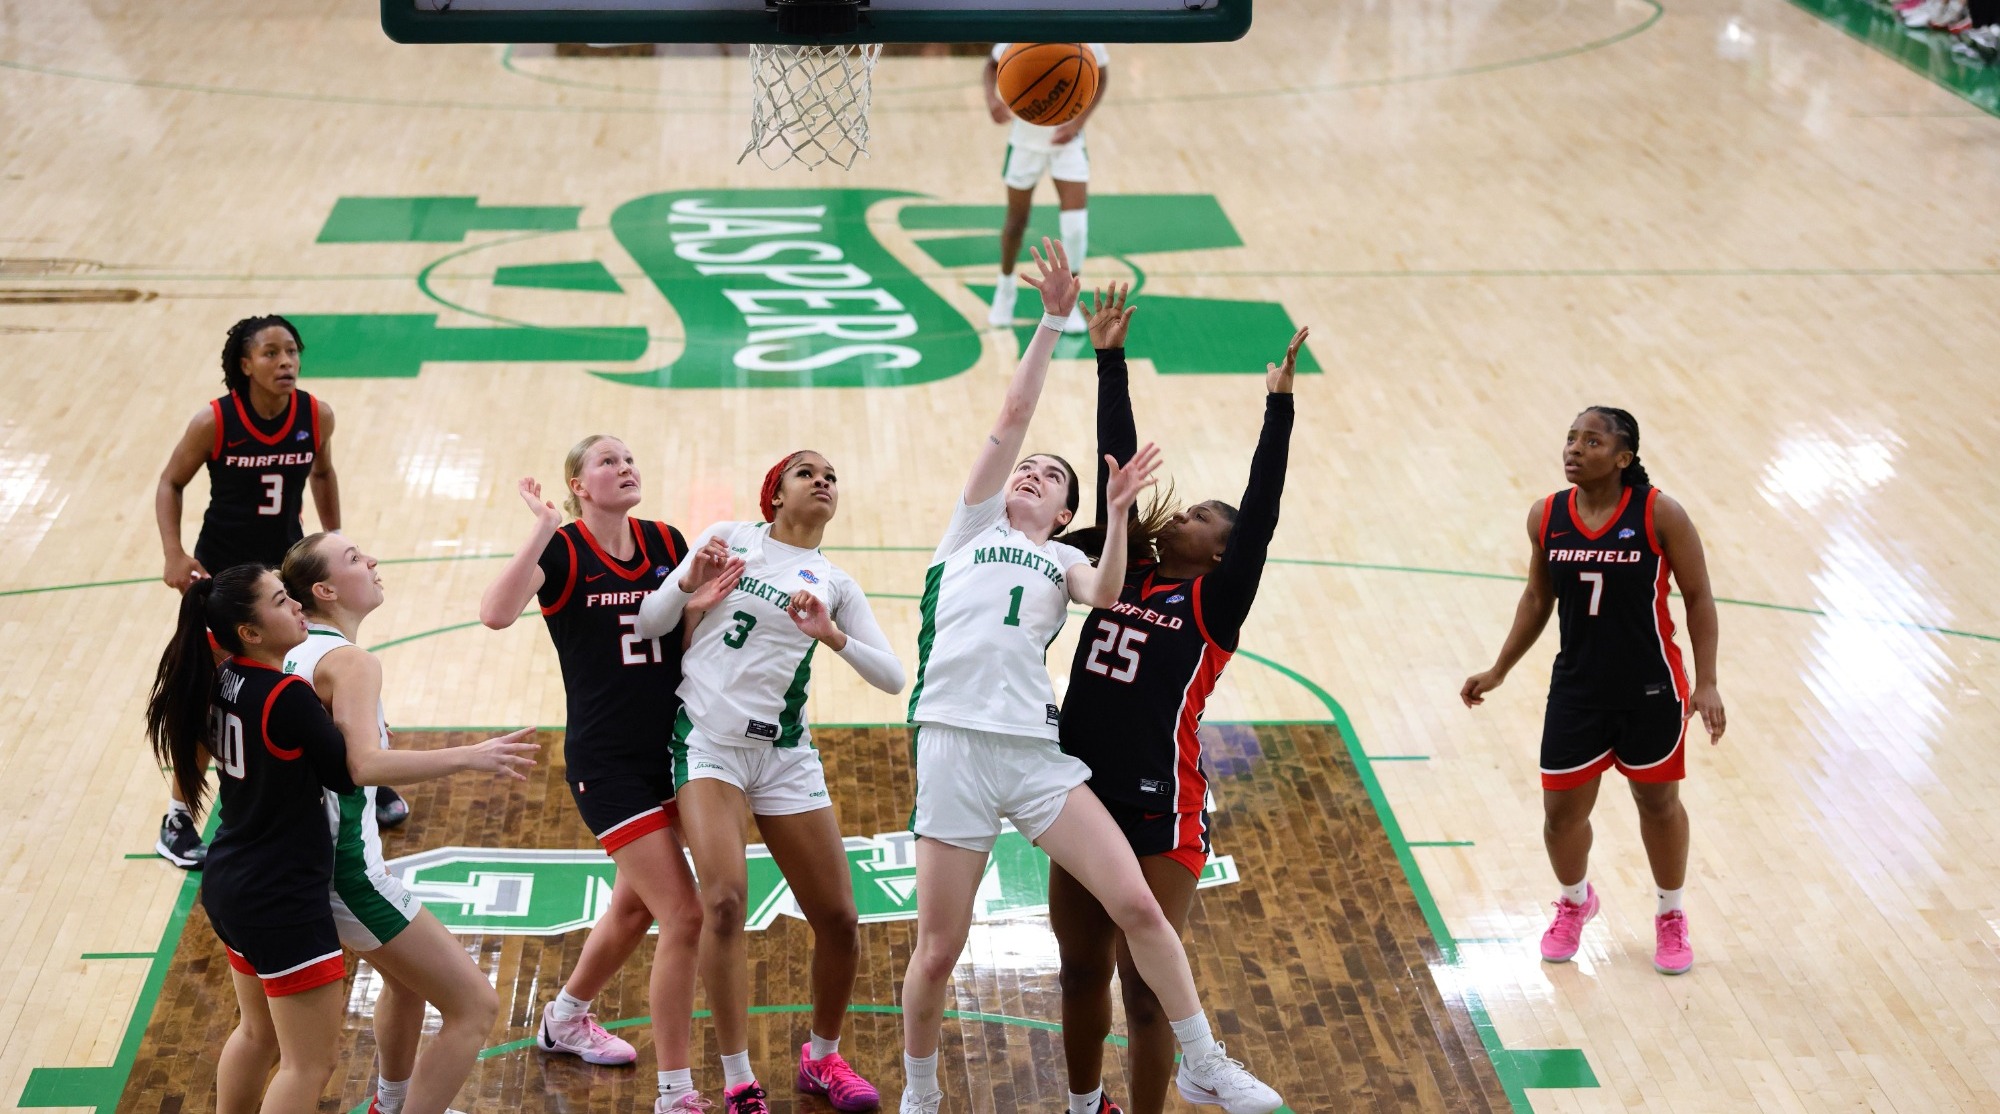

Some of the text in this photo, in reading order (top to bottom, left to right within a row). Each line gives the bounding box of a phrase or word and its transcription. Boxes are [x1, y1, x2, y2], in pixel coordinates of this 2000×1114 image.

[667, 198, 923, 372] JASPERS
[225, 451, 314, 468] FAIRFIELD
[257, 473, 284, 516] 3
[1548, 549, 1642, 563] FAIRFIELD
[586, 591, 656, 608] FAIRF
[735, 576, 800, 613] NHATTA
[1003, 585, 1025, 627] 1
[1578, 570, 1604, 617] 7
[723, 610, 758, 650] 3
[1086, 619, 1149, 683] 25
